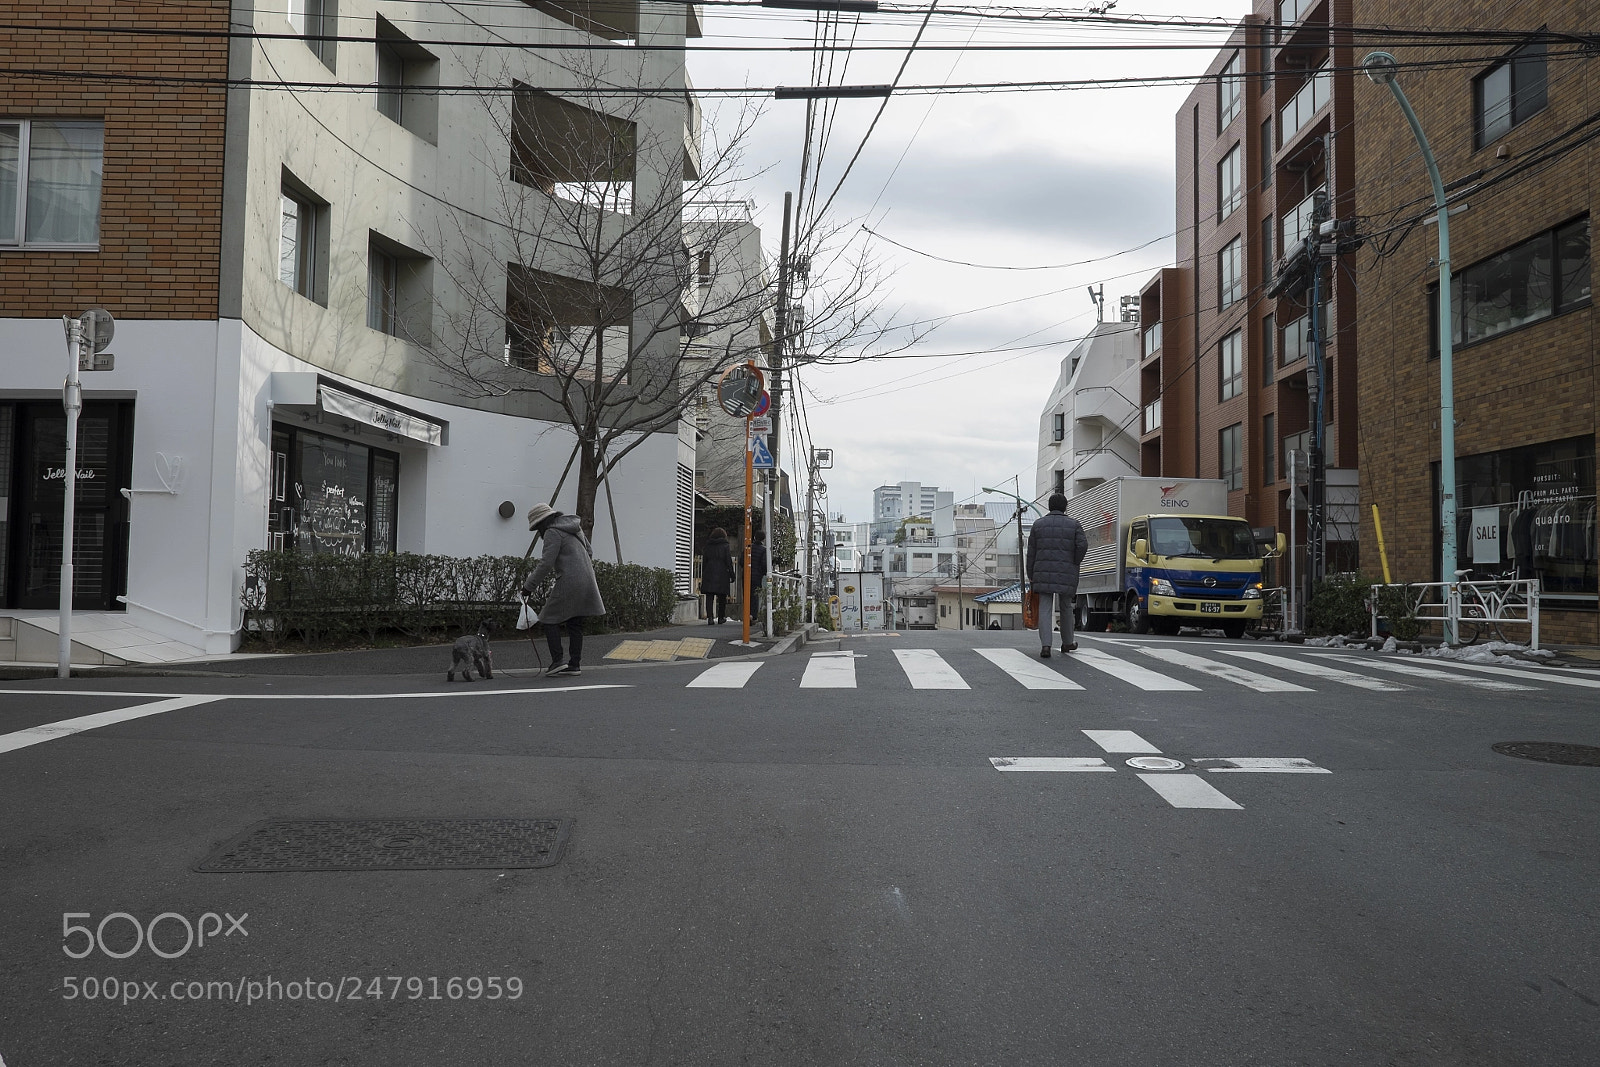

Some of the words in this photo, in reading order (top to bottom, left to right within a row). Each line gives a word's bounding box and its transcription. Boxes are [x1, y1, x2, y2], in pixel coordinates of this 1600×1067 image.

[373, 411, 389, 429] Jelly
[388, 417, 402, 429] Nail
[43, 468, 66, 480] Jell
[75, 469, 96, 479] Nail
[1533, 474, 1561, 483] PURSUIT:
[326, 484, 345, 499] perfect
[1533, 490, 1547, 498] FROM
[1549, 488, 1560, 496] ALL
[1561, 486, 1579, 495] PARTS
[1160, 499, 1190, 508] SEINO
[1535, 515, 1571, 527] quadro
[1476, 525, 1497, 540] SALE
[841, 605, 859, 613] クール
